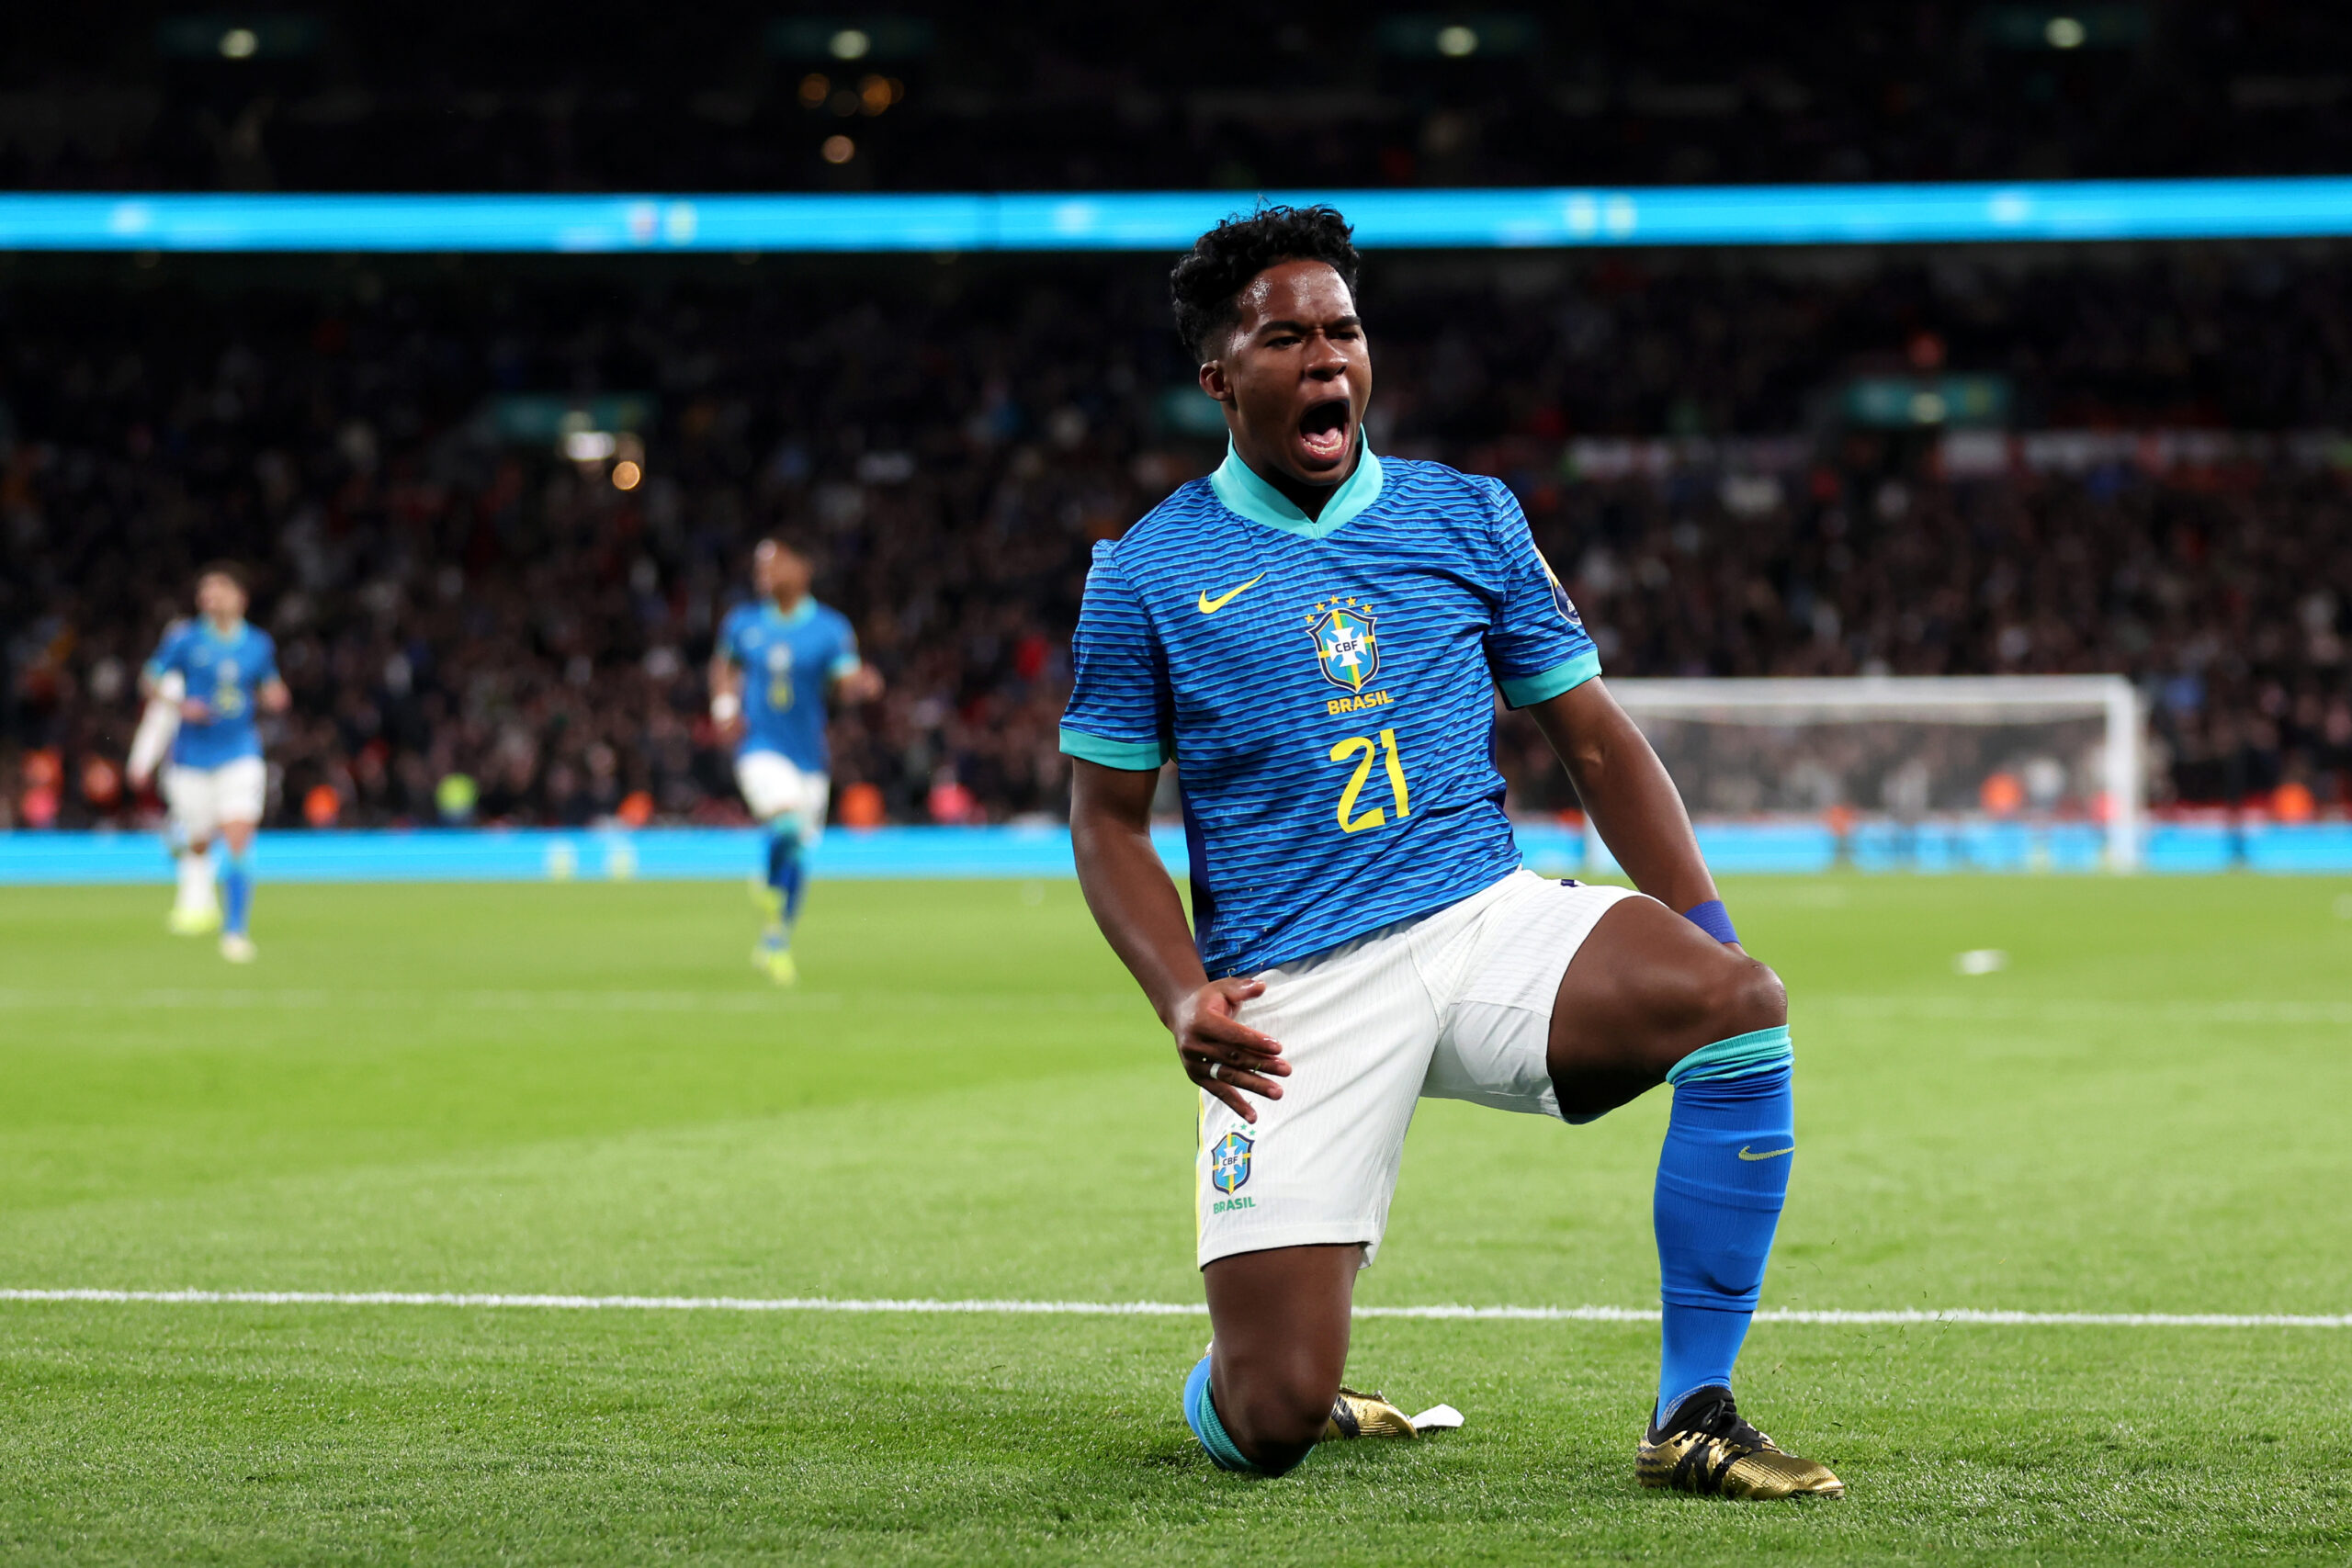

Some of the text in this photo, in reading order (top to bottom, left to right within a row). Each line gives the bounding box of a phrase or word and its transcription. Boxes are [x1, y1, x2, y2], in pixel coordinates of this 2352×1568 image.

[1335, 640, 1358, 653] CBF
[1327, 690, 1394, 715] BRASIL
[1329, 728, 1410, 833] 21
[1222, 1156, 1238, 1166] CBF
[1213, 1197, 1256, 1214] BRASIL
